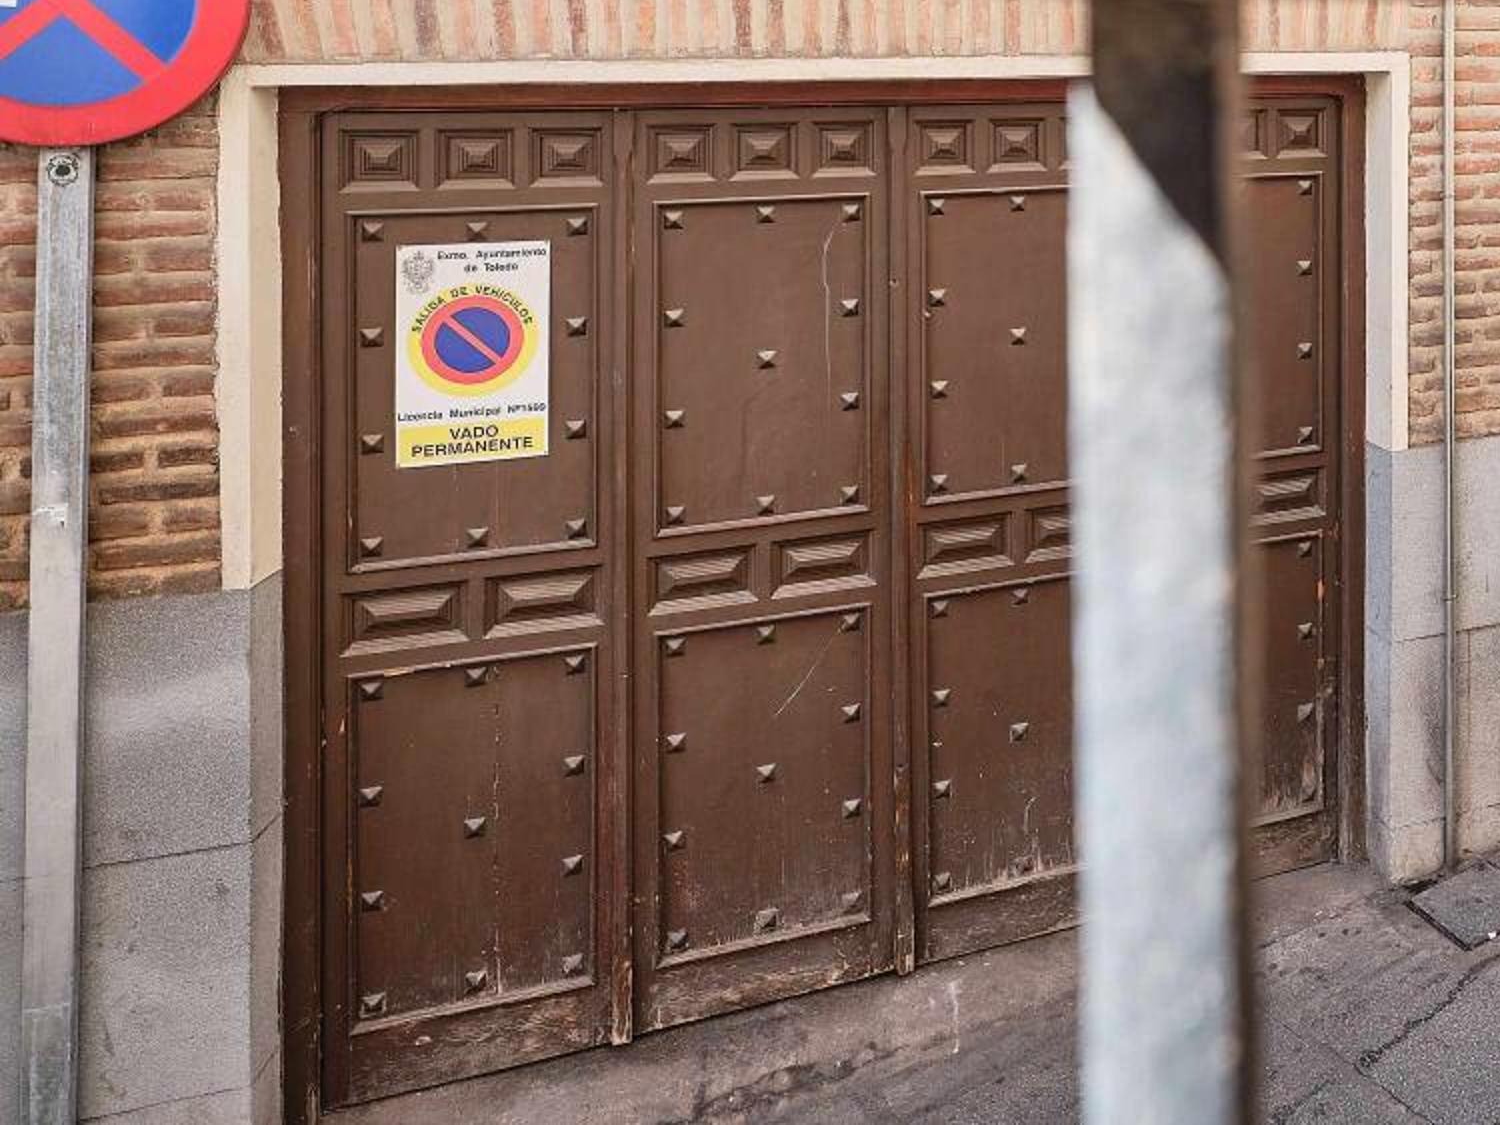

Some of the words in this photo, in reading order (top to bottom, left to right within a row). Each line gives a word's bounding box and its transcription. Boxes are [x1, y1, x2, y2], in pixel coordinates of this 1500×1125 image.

[475, 247, 547, 260] Ayuntamiento
[463, 264, 478, 273] de
[484, 262, 519, 272] Toledo
[411, 296, 446, 332] SALIDA
[449, 286, 468, 298] DE
[397, 410, 443, 422] Licencia
[449, 406, 501, 418] Municipal
[449, 424, 499, 440] VADO
[411, 436, 534, 458] PERMANENTE
